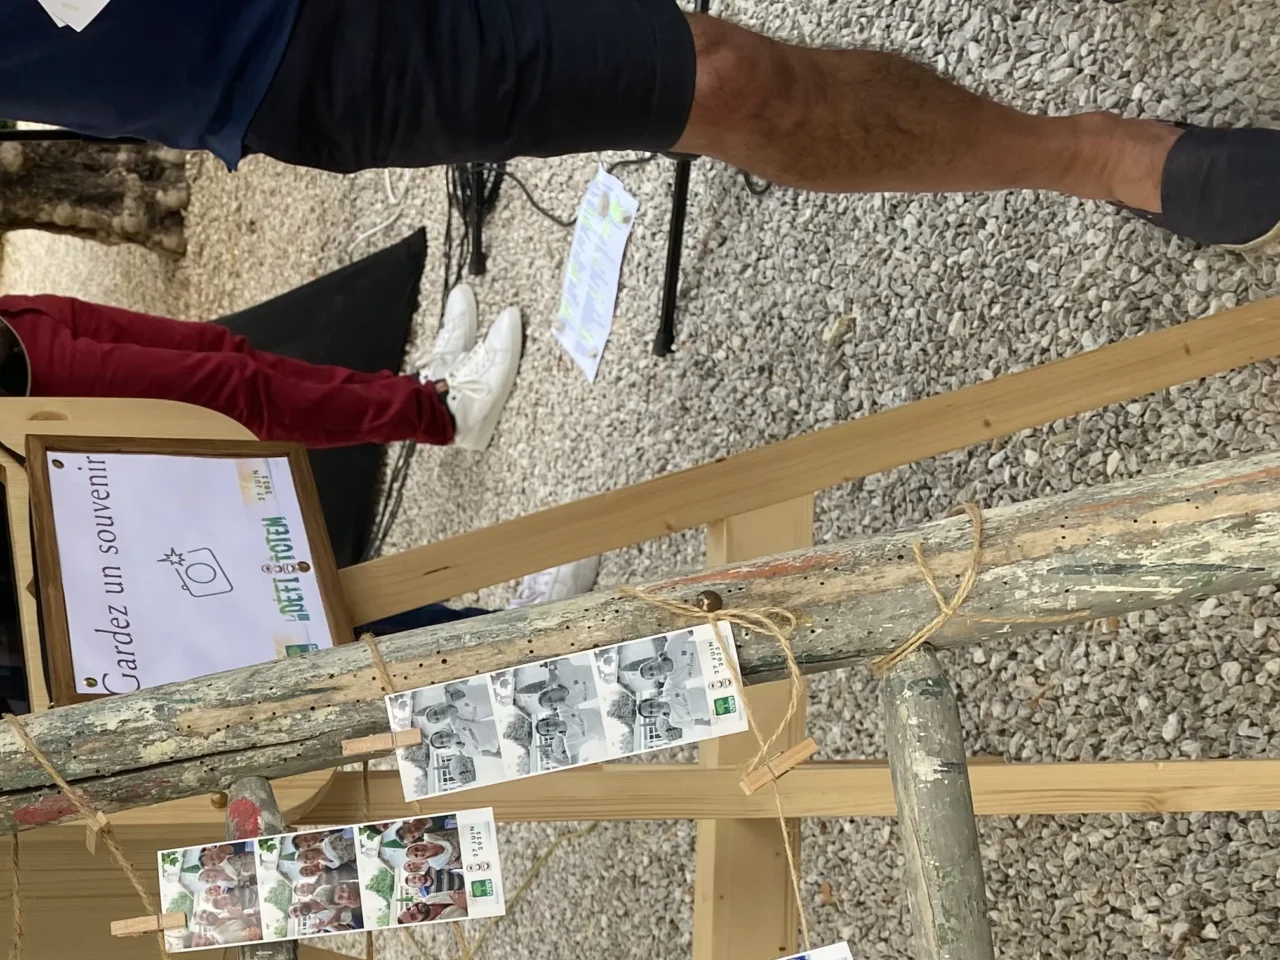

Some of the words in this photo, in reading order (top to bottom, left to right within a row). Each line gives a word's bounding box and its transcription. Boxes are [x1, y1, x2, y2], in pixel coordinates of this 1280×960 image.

[252, 470, 263, 488] JUIN
[77, 455, 119, 555] souvenir
[261, 516, 296, 562] TOTEM
[100, 566, 124, 594] un
[94, 605, 140, 694] Gardez
[708, 641, 717, 661] JUIN
[469, 825, 477, 844] JUIN
